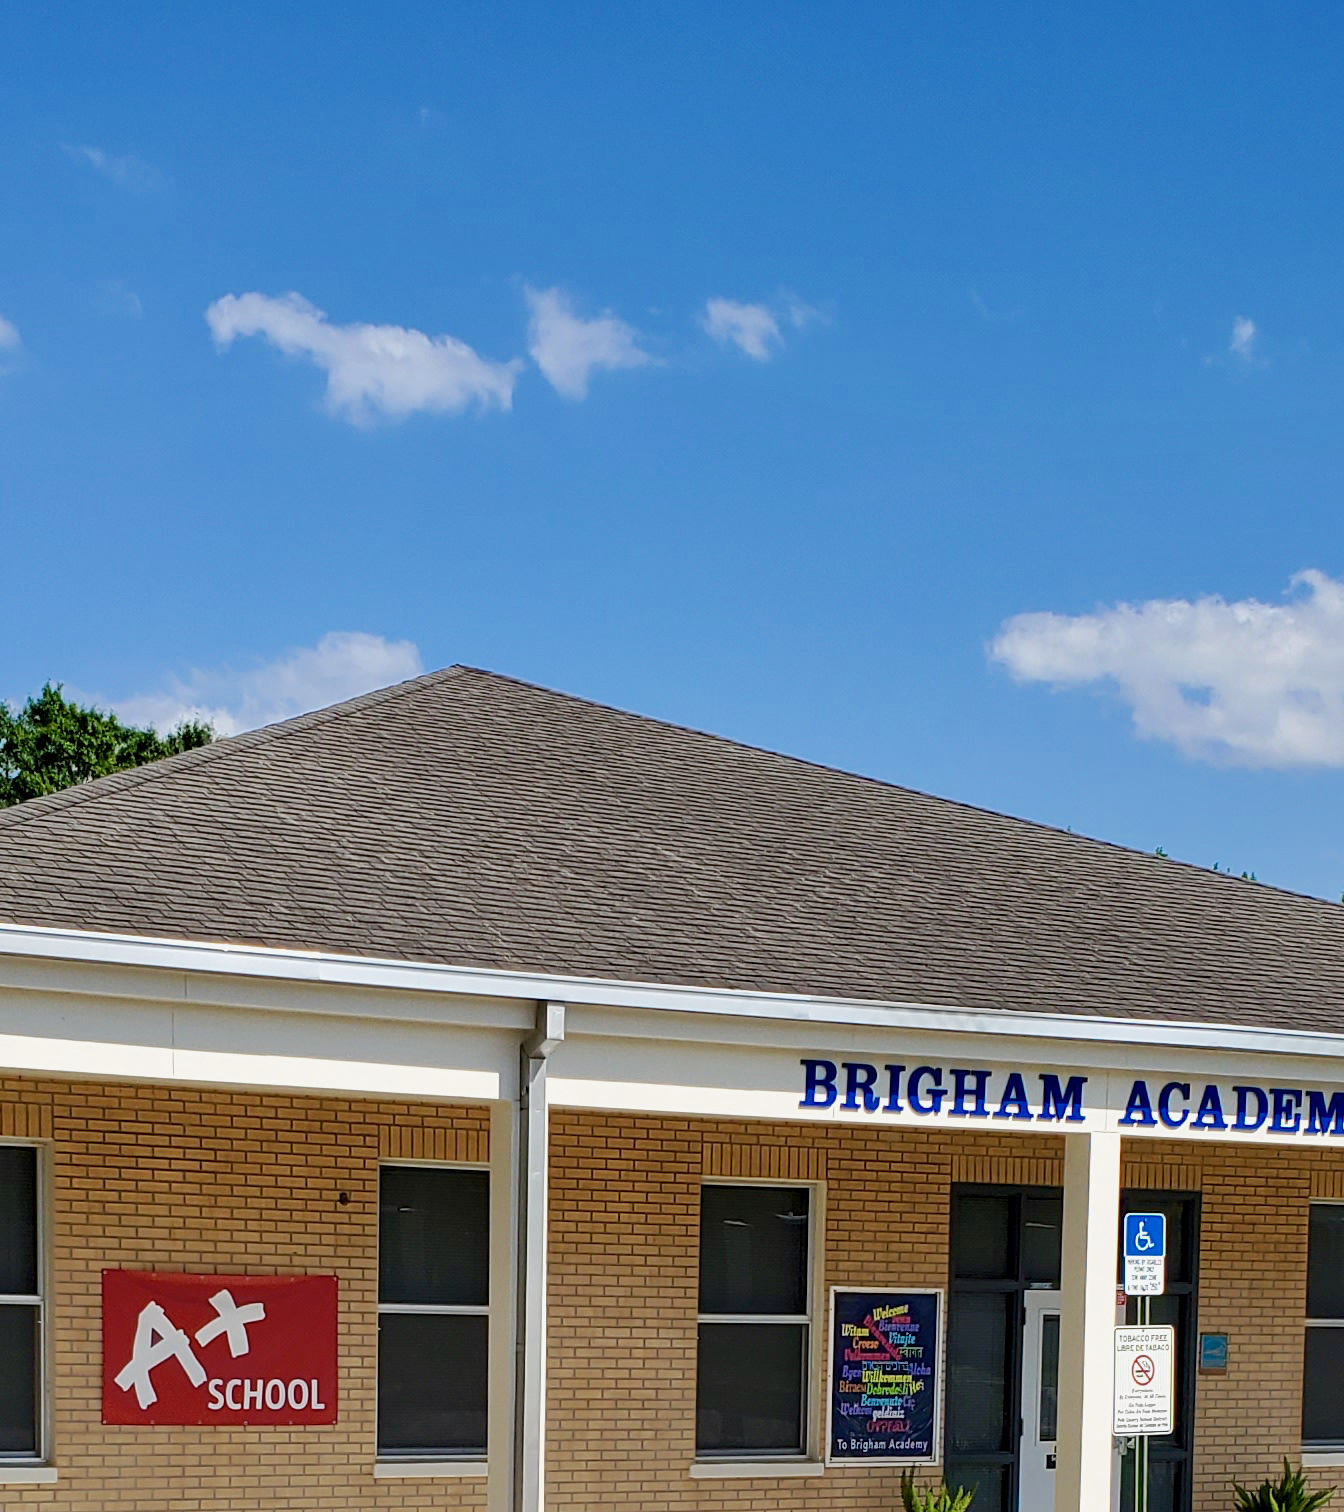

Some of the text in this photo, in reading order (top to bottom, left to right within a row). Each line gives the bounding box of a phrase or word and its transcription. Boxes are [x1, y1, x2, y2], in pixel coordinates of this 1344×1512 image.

[799, 1058, 1089, 1123] BRIGHAM
[873, 1304, 909, 1321] Welcome
[841, 1323, 870, 1337] Witam
[1119, 1334, 1168, 1342] TOBACCO FREE
[889, 1332, 917, 1348] Vitajte
[114, 1288, 266, 1410] A+
[862, 1369, 913, 1383] Willkommen
[207, 1378, 326, 1410] SCHOOL
[837, 1438, 928, 1453] To Brigham Academy
